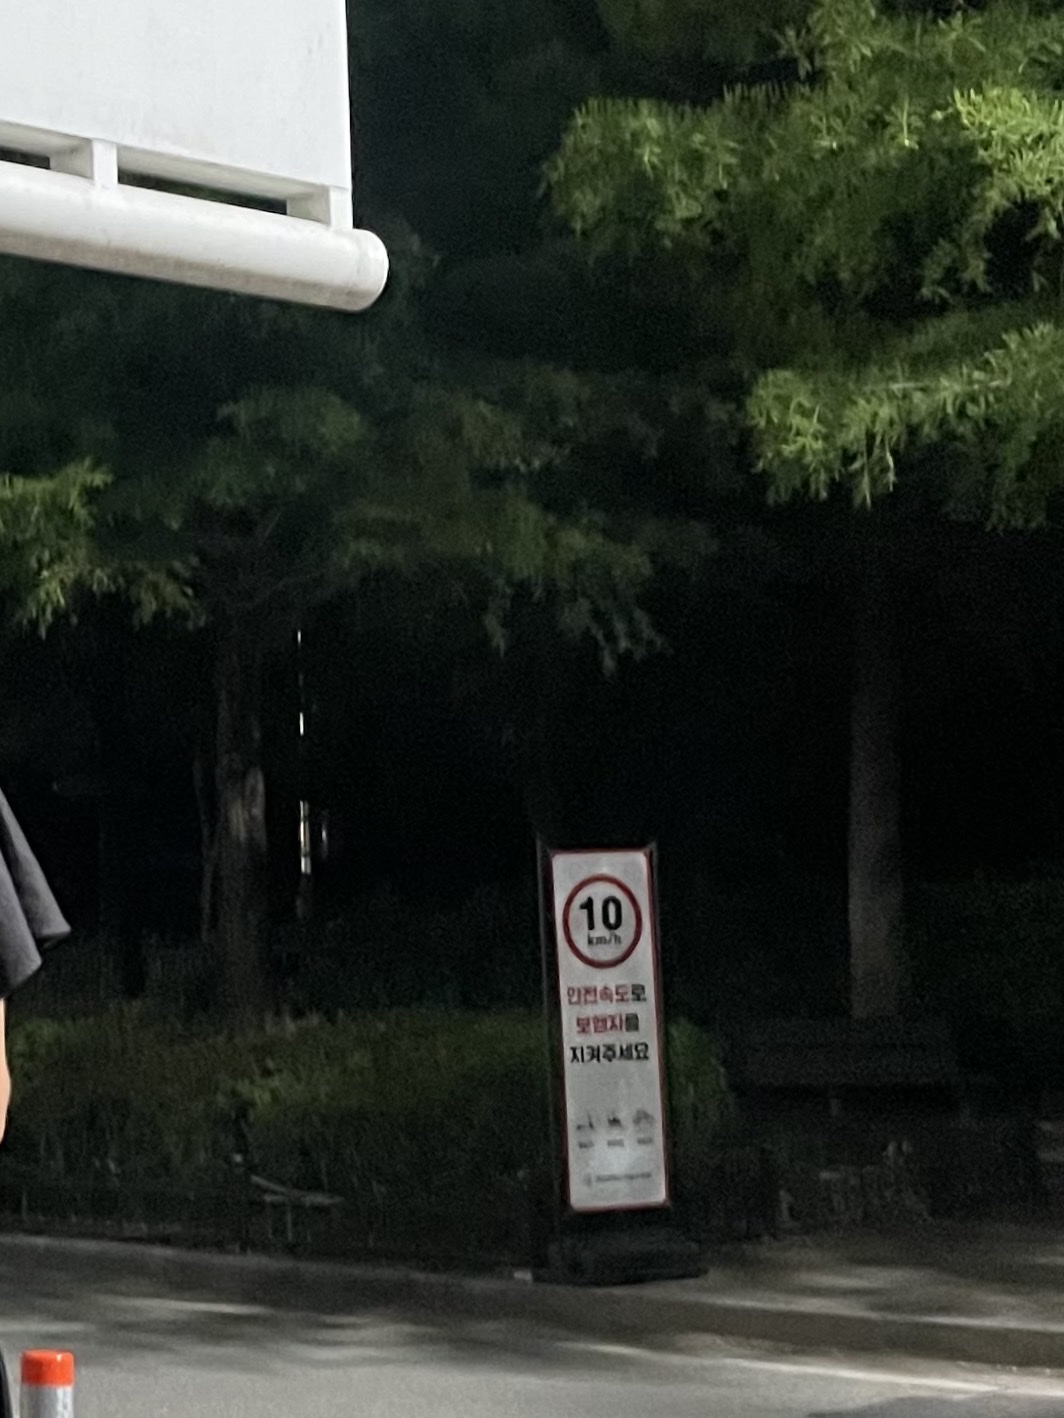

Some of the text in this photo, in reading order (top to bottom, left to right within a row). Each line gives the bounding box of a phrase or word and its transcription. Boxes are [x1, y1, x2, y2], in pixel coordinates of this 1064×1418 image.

[579, 896, 623, 931] 10
[587, 932, 622, 946] km/h
[567, 984, 647, 1006] 안전속도로
[570, 1042, 649, 1064] 지켜주세요
